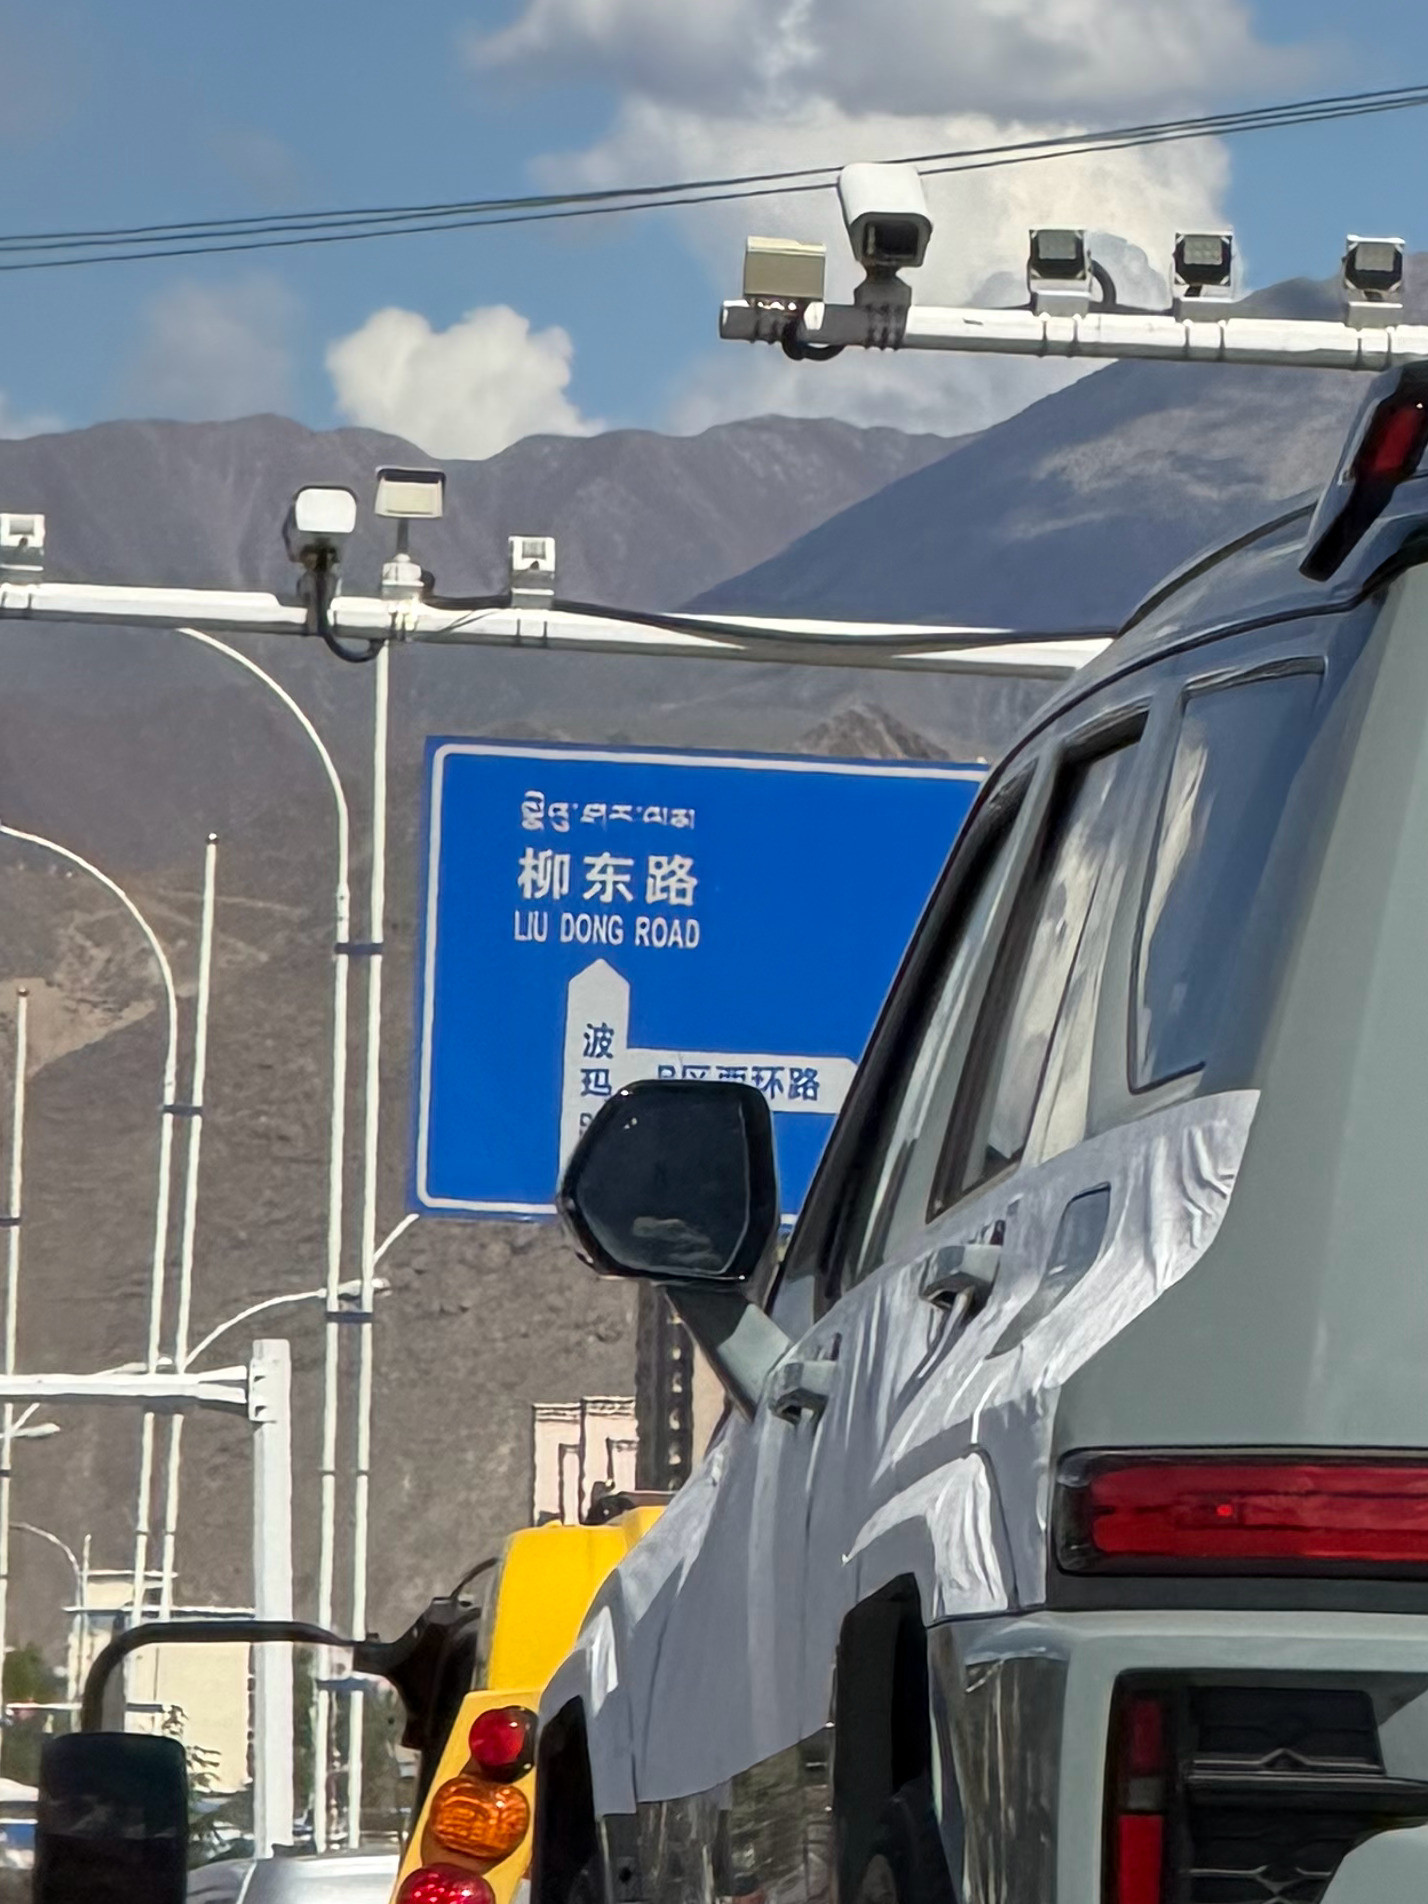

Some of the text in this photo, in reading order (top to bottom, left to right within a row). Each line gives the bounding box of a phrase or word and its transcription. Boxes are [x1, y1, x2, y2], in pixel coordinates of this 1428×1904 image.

[516, 848, 698, 906] 柳东路
[514, 910, 699, 949] LIU DONG ROAD
[579, 1022, 615, 1140] 波玛
